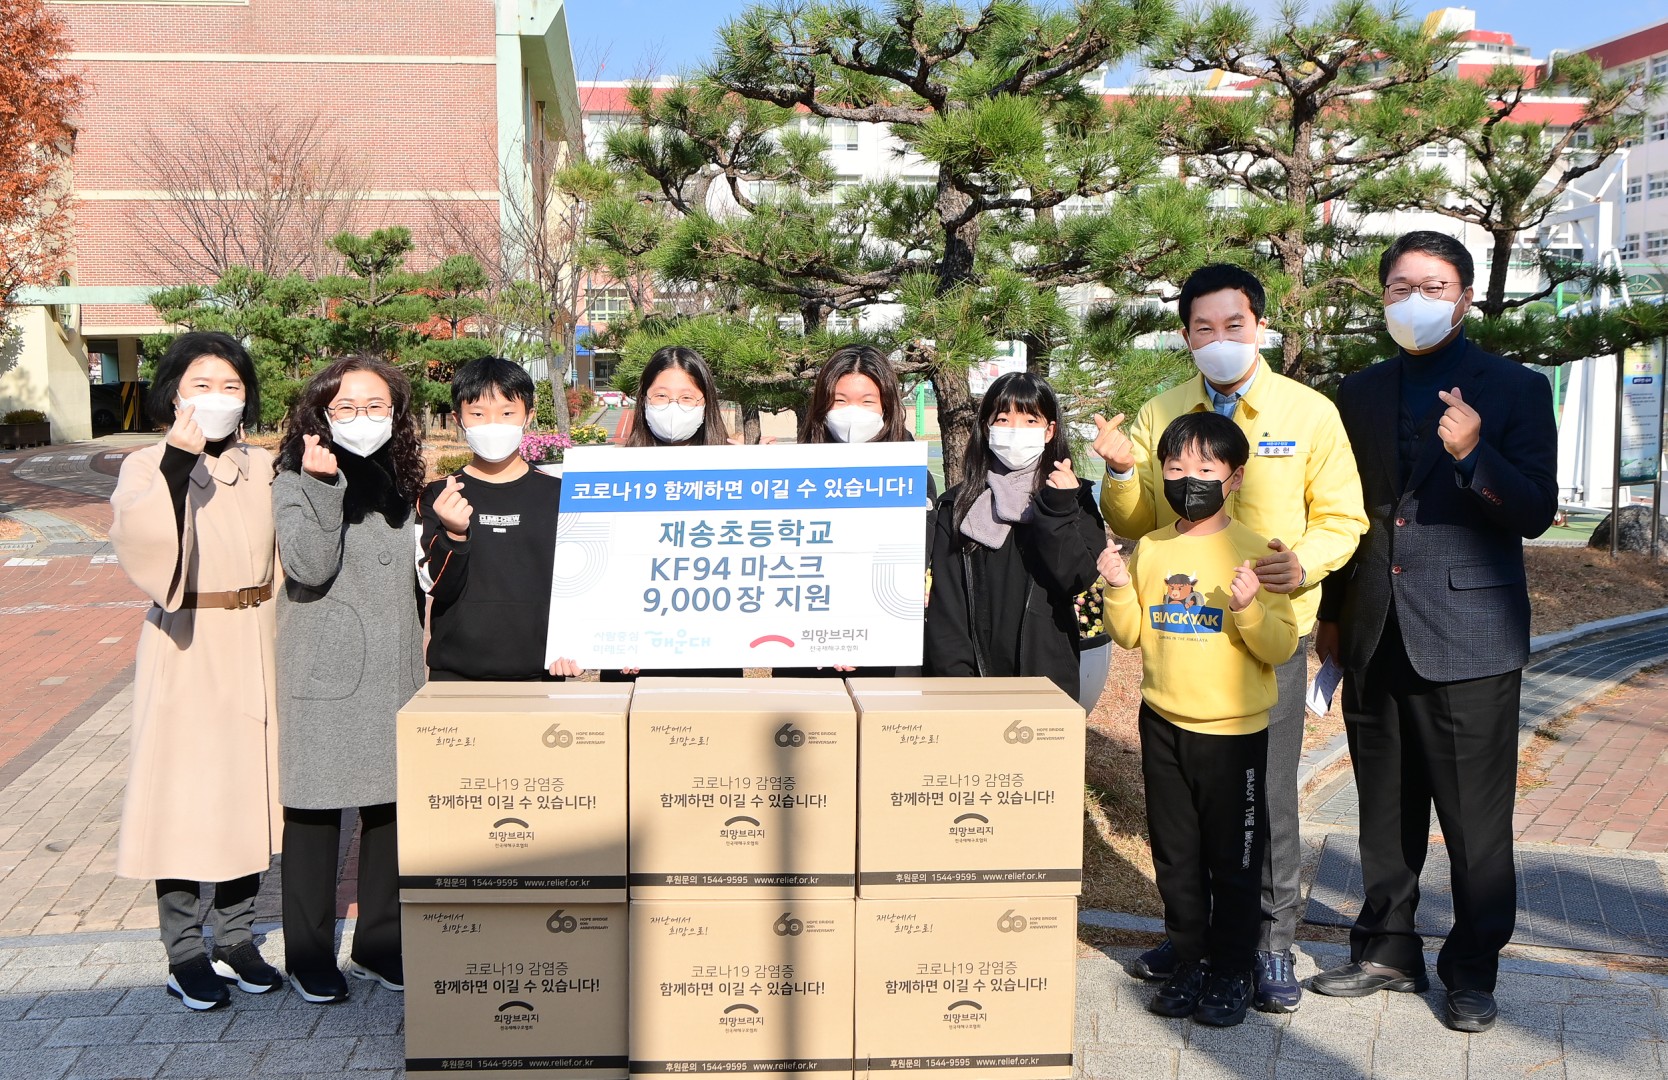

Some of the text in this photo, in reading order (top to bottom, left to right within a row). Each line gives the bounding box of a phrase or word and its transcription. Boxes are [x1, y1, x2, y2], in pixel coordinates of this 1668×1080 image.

[571, 478, 914, 501] 코로나19 함께하면 이길 수 있습니다!
[659, 520, 833, 547] 재송초등학교
[651, 555, 824, 581] KF94 마스크
[776, 585, 830, 612] 지원
[645, 629, 711, 654] 해운대
[801, 629, 868, 643] 희망브리지
[416, 726, 458, 734] 재난에서
[651, 725, 692, 734] 재난에서
[882, 724, 922, 733] 재난에서
[460, 778, 564, 792] 코로나19 감염증
[692, 776, 796, 790] 코로나19 감염증
[922, 773, 1024, 787] 코로나19 감염증
[428, 795, 596, 809] 함께하면 이길 수 있습니다!
[660, 794, 827, 808] 함께하면 이길 수 있습니다!
[891, 791, 1054, 806] 함께하면 이길 수 있습니다!
[1244, 806, 1255, 826] THE
[488, 831, 534, 842] 희망브리지
[720, 829, 765, 839] 희망브리지
[949, 827, 993, 837] 희망브리지
[435, 878, 590, 888] 후원문의 1544-9595 www.relief.or.kr
[665, 875, 698, 884] 후원문의
[754, 876, 819, 884] www.relief.or.kr
[895, 872, 1046, 882] 후원문의 1544-9595 www.relief.or.kr
[423, 914, 464, 922] 재난에서
[650, 916, 691, 925] 재난에서
[876, 913, 916, 922] 재난에서
[465, 962, 568, 976] 코로나19 감염증
[691, 965, 794, 978] 코로나19 감염증
[916, 962, 1017, 976] 코로나19 감염증
[434, 979, 600, 994] 함께하면 이길 수 있습니다!
[660, 982, 825, 996] 함께하면 이길 수 있습니다!
[885, 978, 1047, 994] 함께하면 이길 수 있습니다!
[494, 1014, 539, 1024] 희망브리지
[719, 1017, 764, 1027] 희망브리지
[943, 1013, 987, 1023] 희망브리지
[441, 1059, 594, 1069] 후원문의 1544-9595 www.relief.or.kr
[665, 1063, 697, 1072] 후원문의
[753, 1062, 817, 1070] www.relief.or.kr
[890, 1058, 1039, 1068] 후원문의 1544-9595 www.relief.or.kr
